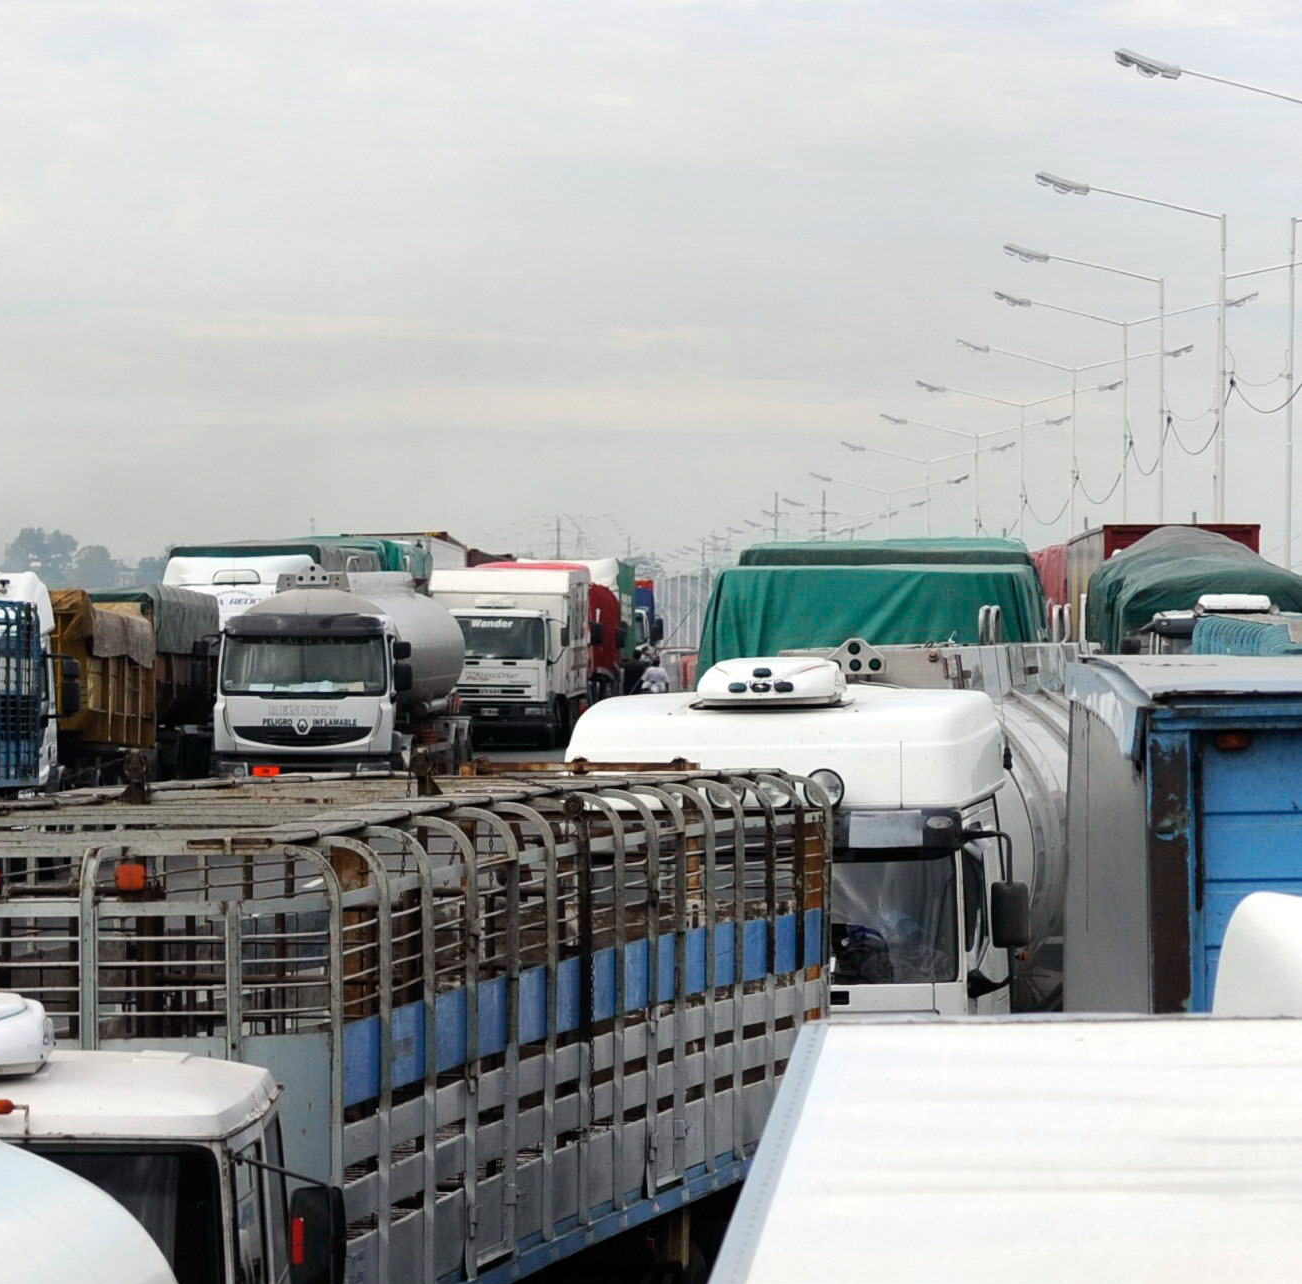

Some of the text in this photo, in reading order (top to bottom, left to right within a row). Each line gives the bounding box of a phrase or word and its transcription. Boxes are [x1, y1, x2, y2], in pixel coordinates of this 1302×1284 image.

[471, 619, 514, 629] Wander
[262, 718, 358, 727] PELIGRO INFLAMABLE
